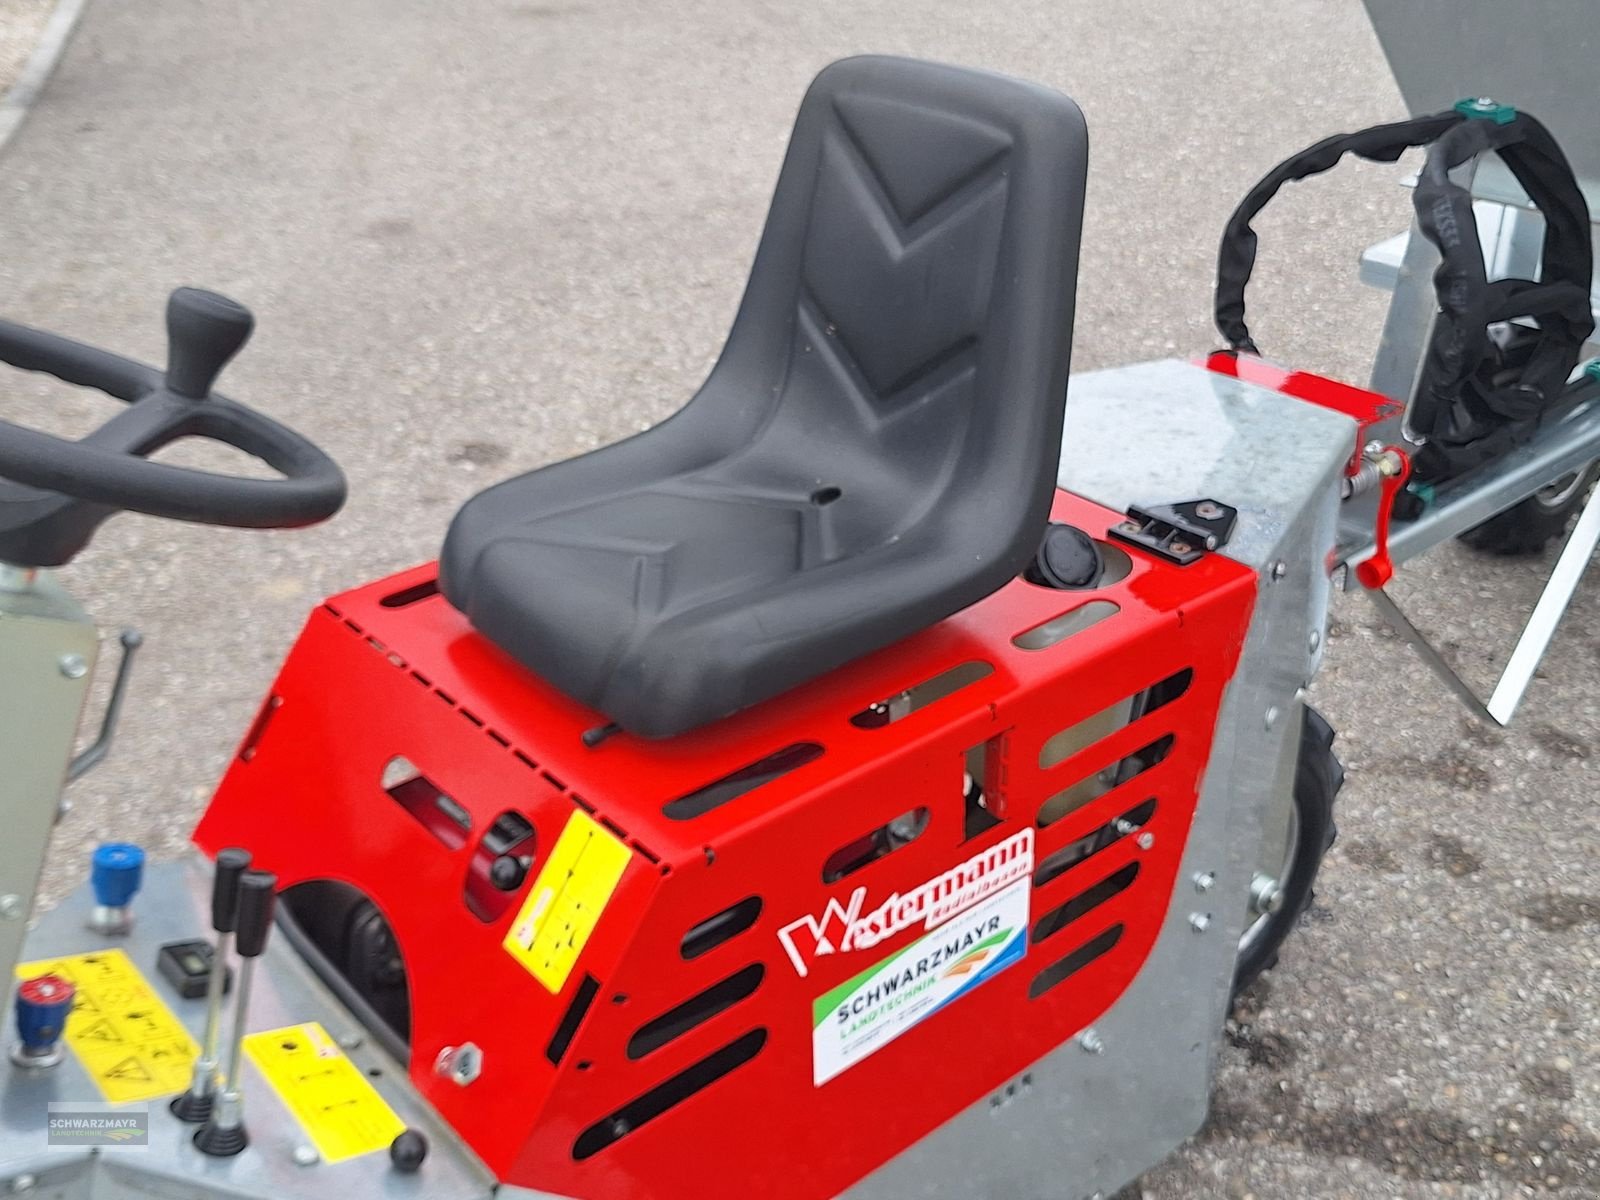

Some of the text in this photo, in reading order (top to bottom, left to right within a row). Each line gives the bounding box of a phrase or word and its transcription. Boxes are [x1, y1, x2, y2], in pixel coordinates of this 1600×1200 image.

[777, 827, 1034, 977] Westermann
[837, 914, 1001, 1025] SCHWARZMAYR
[839, 974, 937, 1040] LANDTECHNIK
